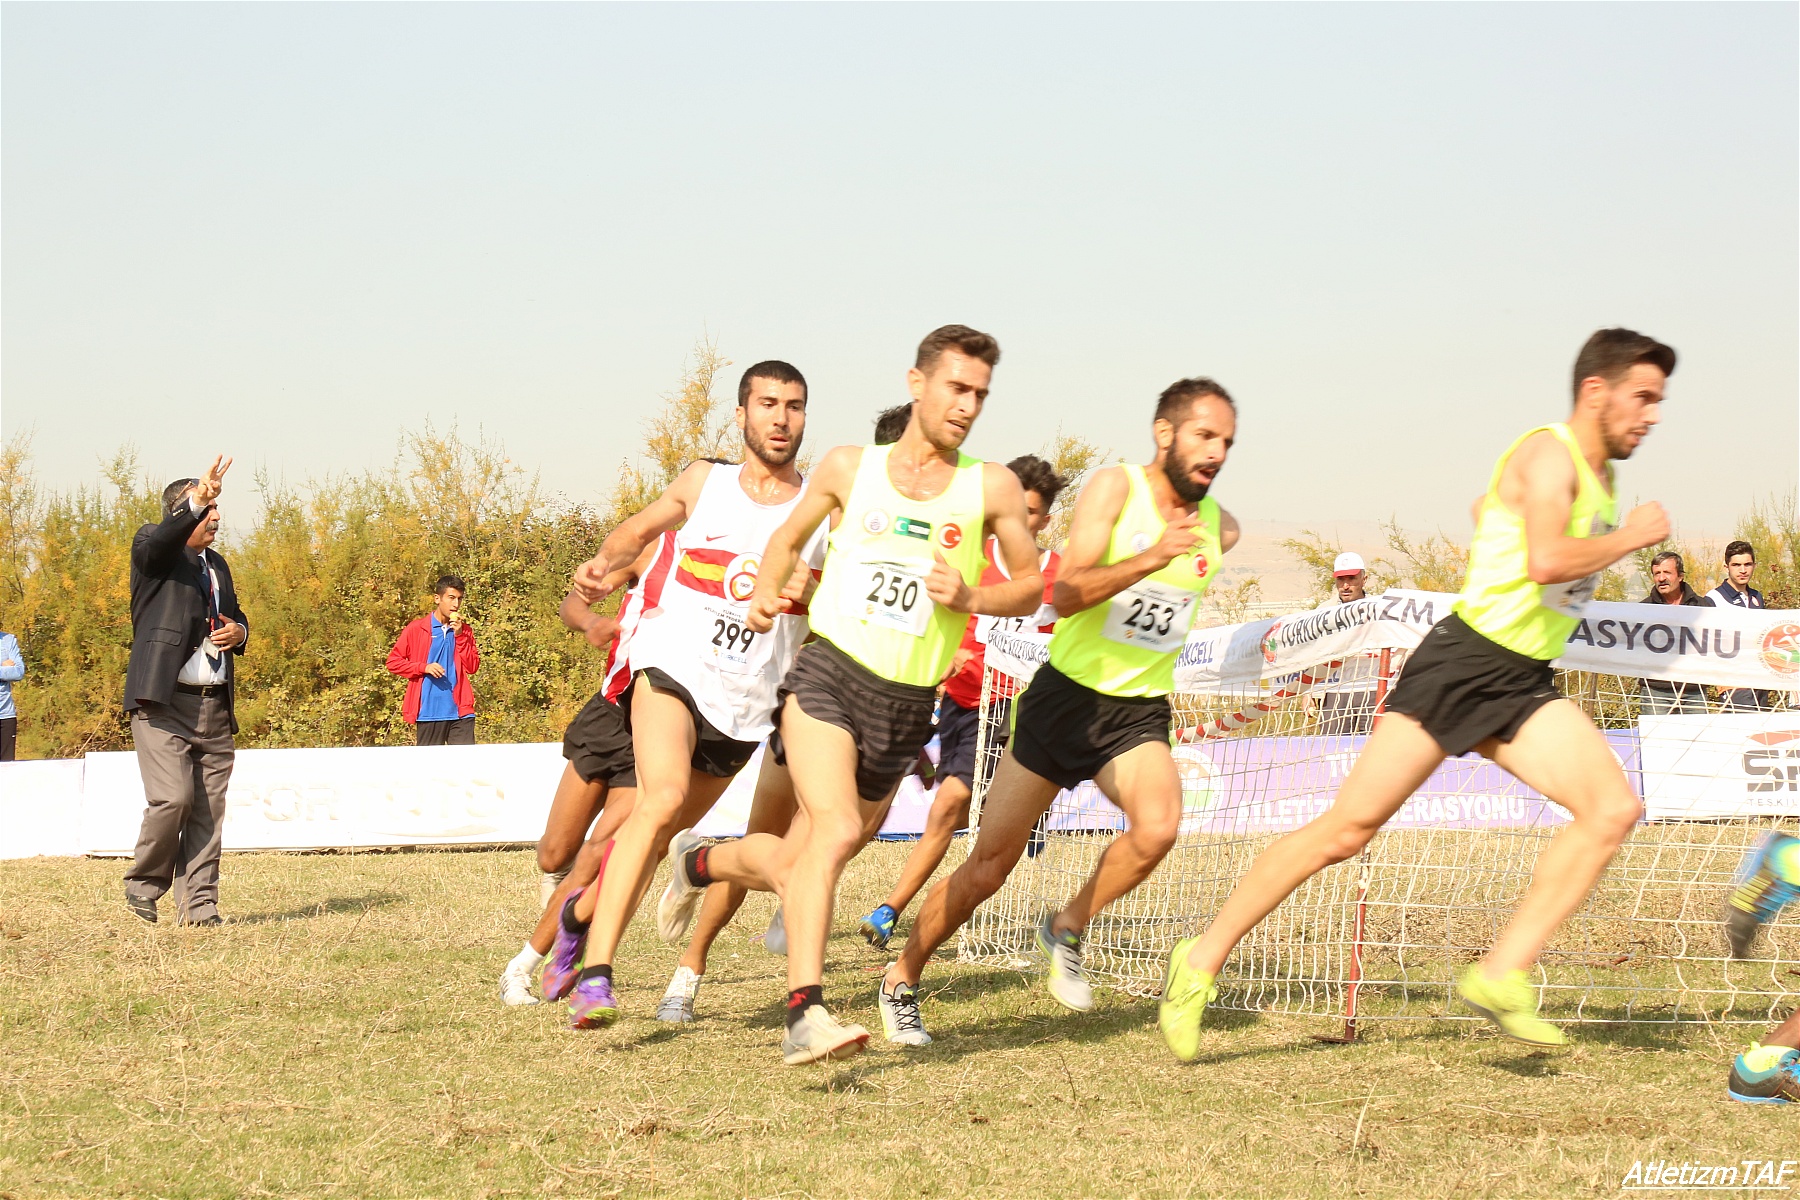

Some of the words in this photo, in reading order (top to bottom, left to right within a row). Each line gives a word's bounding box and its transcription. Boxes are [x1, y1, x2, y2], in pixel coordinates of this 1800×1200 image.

[866, 571, 918, 612] 250
[711, 618, 756, 654] 299
[1122, 597, 1174, 636] 253
[1566, 617, 1741, 659] ASYONU
[1235, 792, 1336, 826] ATLETİZ
